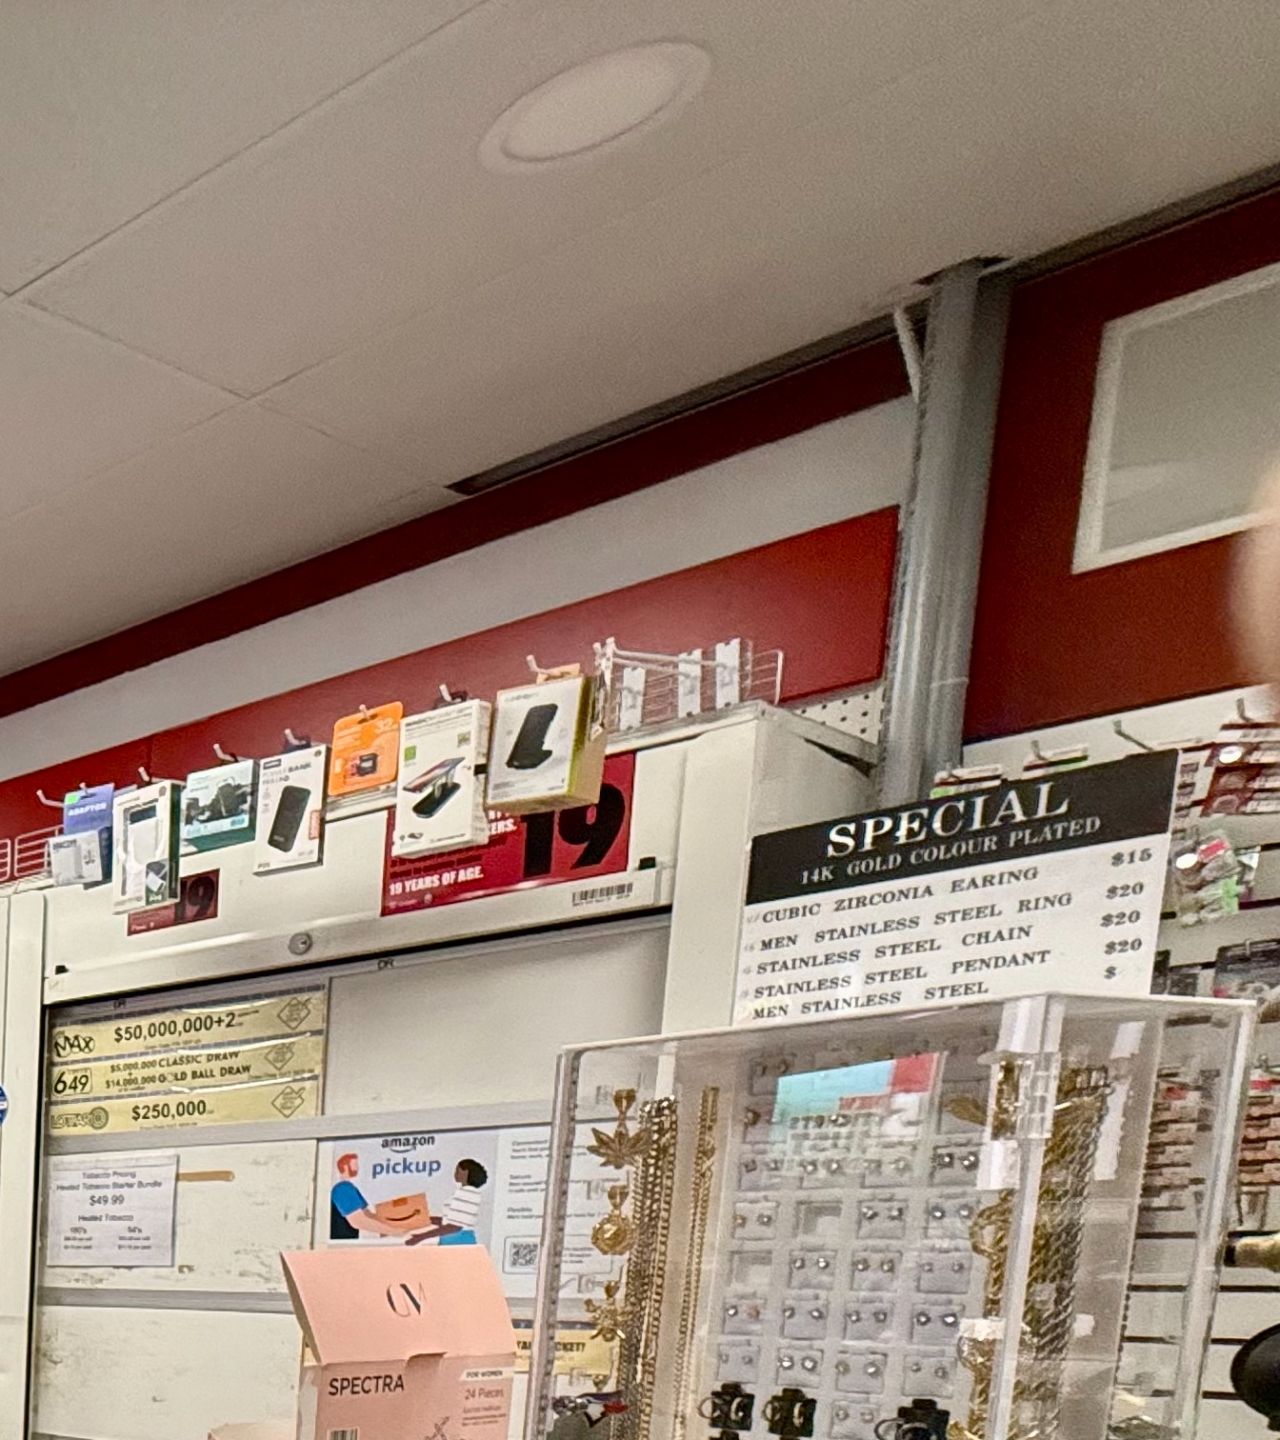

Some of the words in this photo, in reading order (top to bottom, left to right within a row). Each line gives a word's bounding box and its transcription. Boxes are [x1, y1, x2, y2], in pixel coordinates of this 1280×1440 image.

[520, 783, 626, 878] 19
[827, 781, 1069, 857] SPECIAL
[801, 865, 834, 884] 14K
[847, 854, 902, 876] GOLD
[910, 835, 997, 865] COLOUR
[1009, 816, 1101, 848] PLATED
[390, 883, 404, 896] 19
[405, 874, 441, 893] YEARS
[442, 870, 457, 886] OF
[458, 866, 484, 883] AGE.
[763, 903, 821, 923] CUBIC
[834, 885, 934, 912] ZIRCONIA
[950, 866, 1038, 894] EARING
[1111, 848, 1153, 867] $15
[760, 934, 798, 950] MEN
[814, 915, 920, 943] STAINLESS
[934, 904, 1002, 925] STEEL
[1017, 893, 1072, 914] RING
[1105, 882, 1144, 900] $20
[757, 949, 861, 975] STAINLESS
[874, 938, 942, 959] STEEL
[962, 925, 1033, 946] CHAIN
[1100, 910, 1141, 928] $20
[754, 975, 851, 999] STAINLESS
[864, 965, 927, 985] STEEL
[951, 950, 1051, 974] PENDANT
[1104, 938, 1142, 954] $20
[752, 1004, 789, 1020] MEN
[801, 991, 902, 1015] STAINLESS
[924, 981, 989, 1001] STEEL
[54, 1034, 95, 1058] MAX
[158, 1053, 202, 1067] CLASSIC
[207, 1051, 239, 1063] DRAW
[192, 1069, 214, 1080] BALL
[220, 1065, 251, 1077] DRAW
[132, 1100, 207, 1121] $250,000
[381, 1134, 436, 1149] amazon
[371, 1156, 441, 1179] pickup
[329, 1374, 404, 1396] SPECTRA
[480, 1369, 503, 1379] WOMEN
[465, 1388, 476, 1400] 24
[478, 1387, 504, 1400] Pieces
